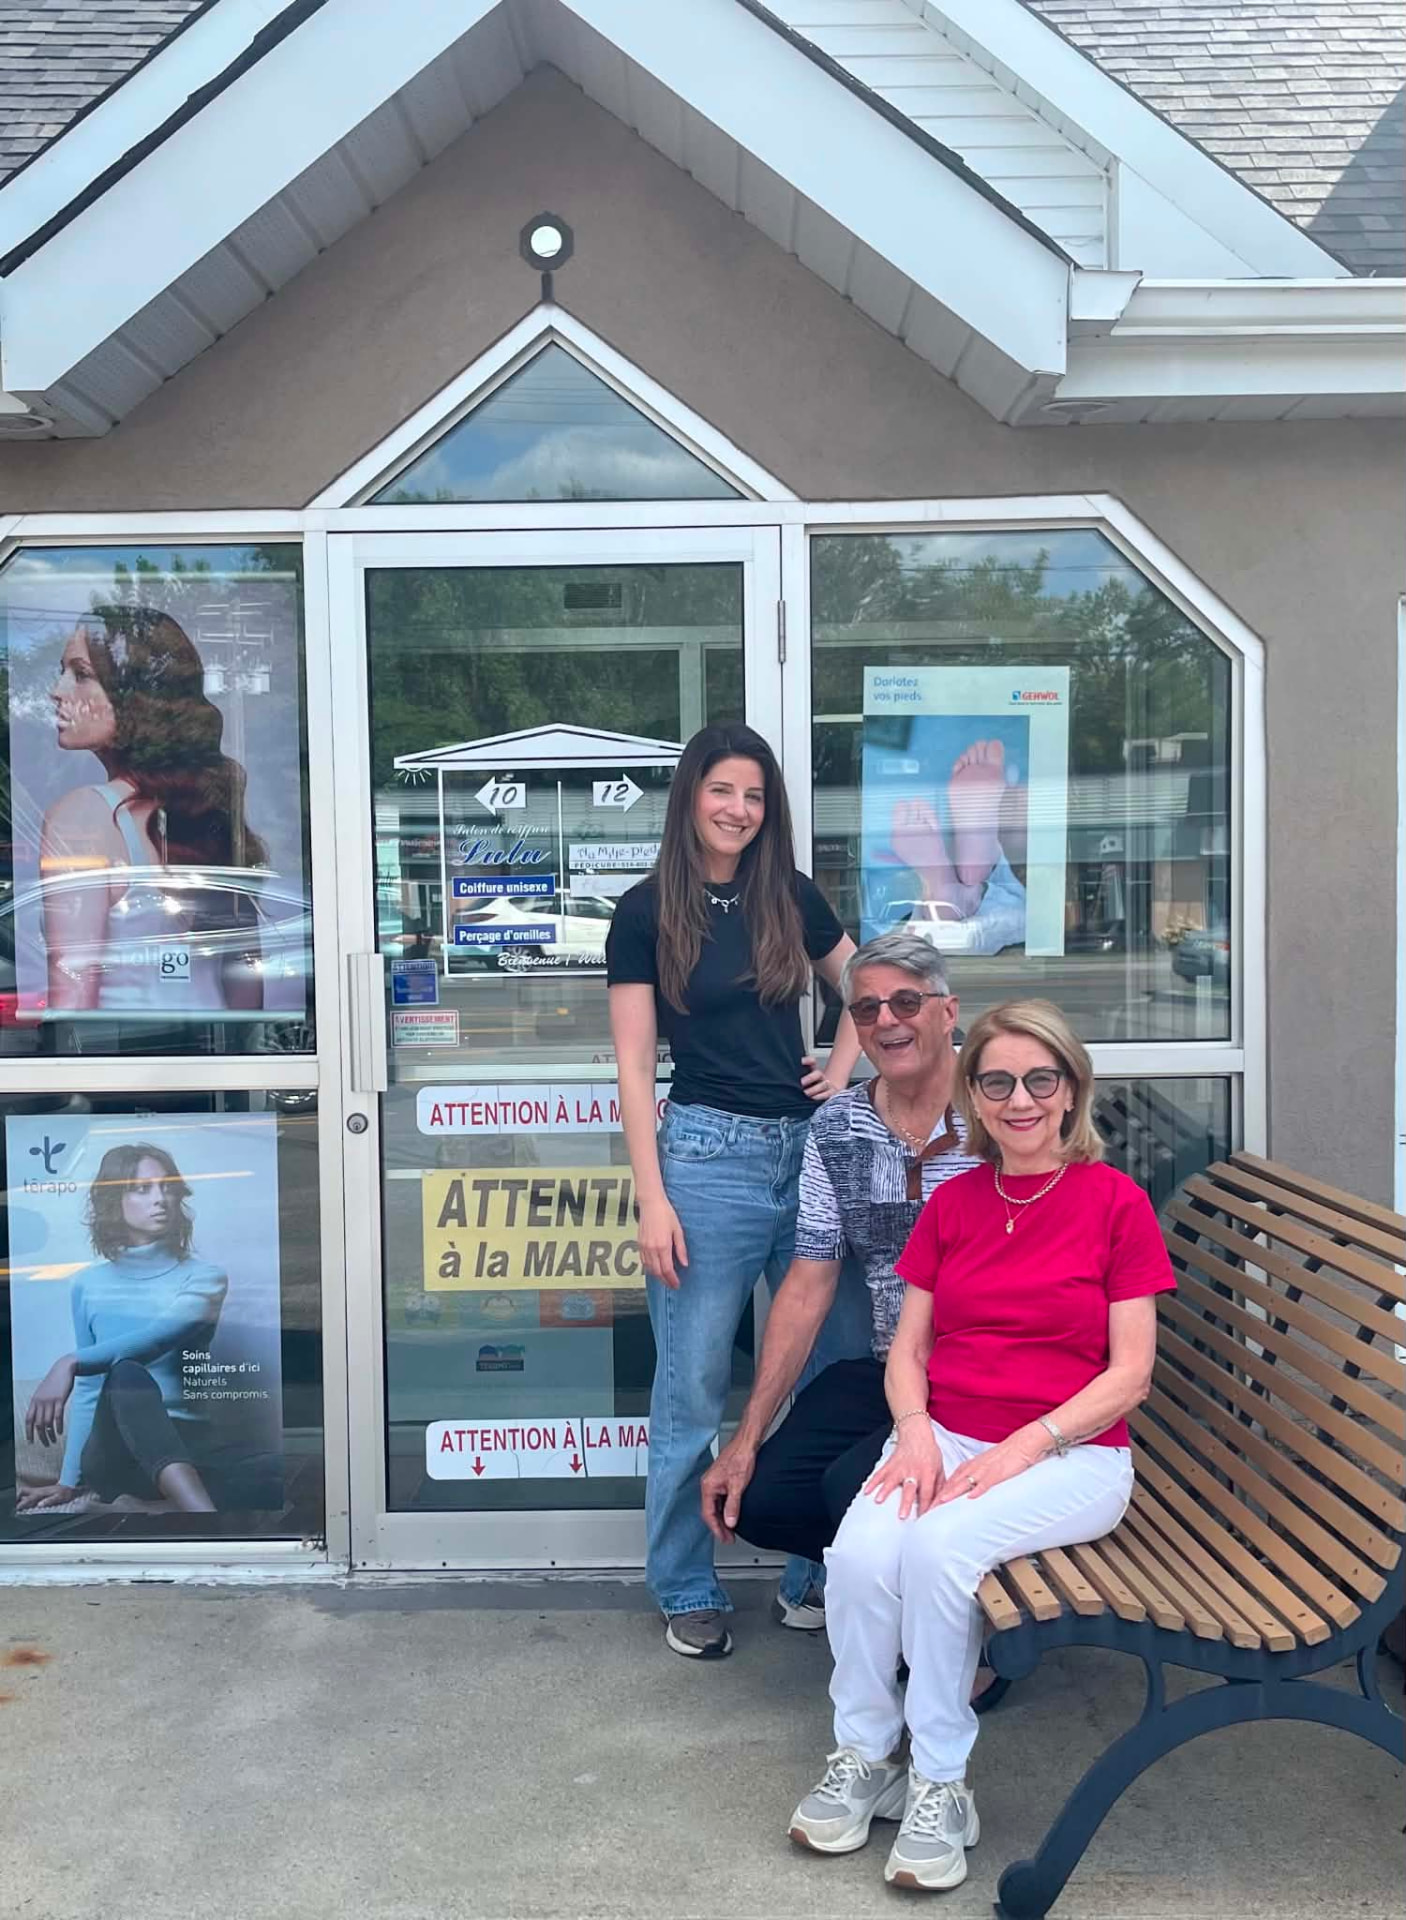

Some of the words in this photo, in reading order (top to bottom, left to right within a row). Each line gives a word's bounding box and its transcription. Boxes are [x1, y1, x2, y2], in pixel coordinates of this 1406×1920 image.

[490, 786, 517, 805] 10
[602, 783, 629, 803] 12
[491, 824, 502, 834] de
[451, 839, 552, 866] Lulu
[460, 882, 503, 894] Coiffure
[506, 881, 548, 893] unisexe
[459, 930, 500, 943] Perçage
[503, 929, 551, 941] d'oreilles
[497, 952, 560, 966] Bienvenue
[430, 1102, 548, 1127] ATTENTION
[555, 1095, 569, 1123] À
[576, 1100, 603, 1123] LA
[437, 1179, 640, 1228] ATTENTI
[439, 1242, 461, 1278] à
[475, 1241, 509, 1278] la
[523, 1240, 645, 1278] MARC
[182, 1350, 211, 1360] Soins
[182, 1362, 237, 1375] capillaires
[239, 1362, 260, 1373] d'ici
[183, 1377, 227, 1387] Naturels
[183, 1389, 208, 1400] Sans
[440, 1428, 556, 1452] ATTENTION
[563, 1421, 577, 1449] À
[586, 1425, 611, 1448] LA
